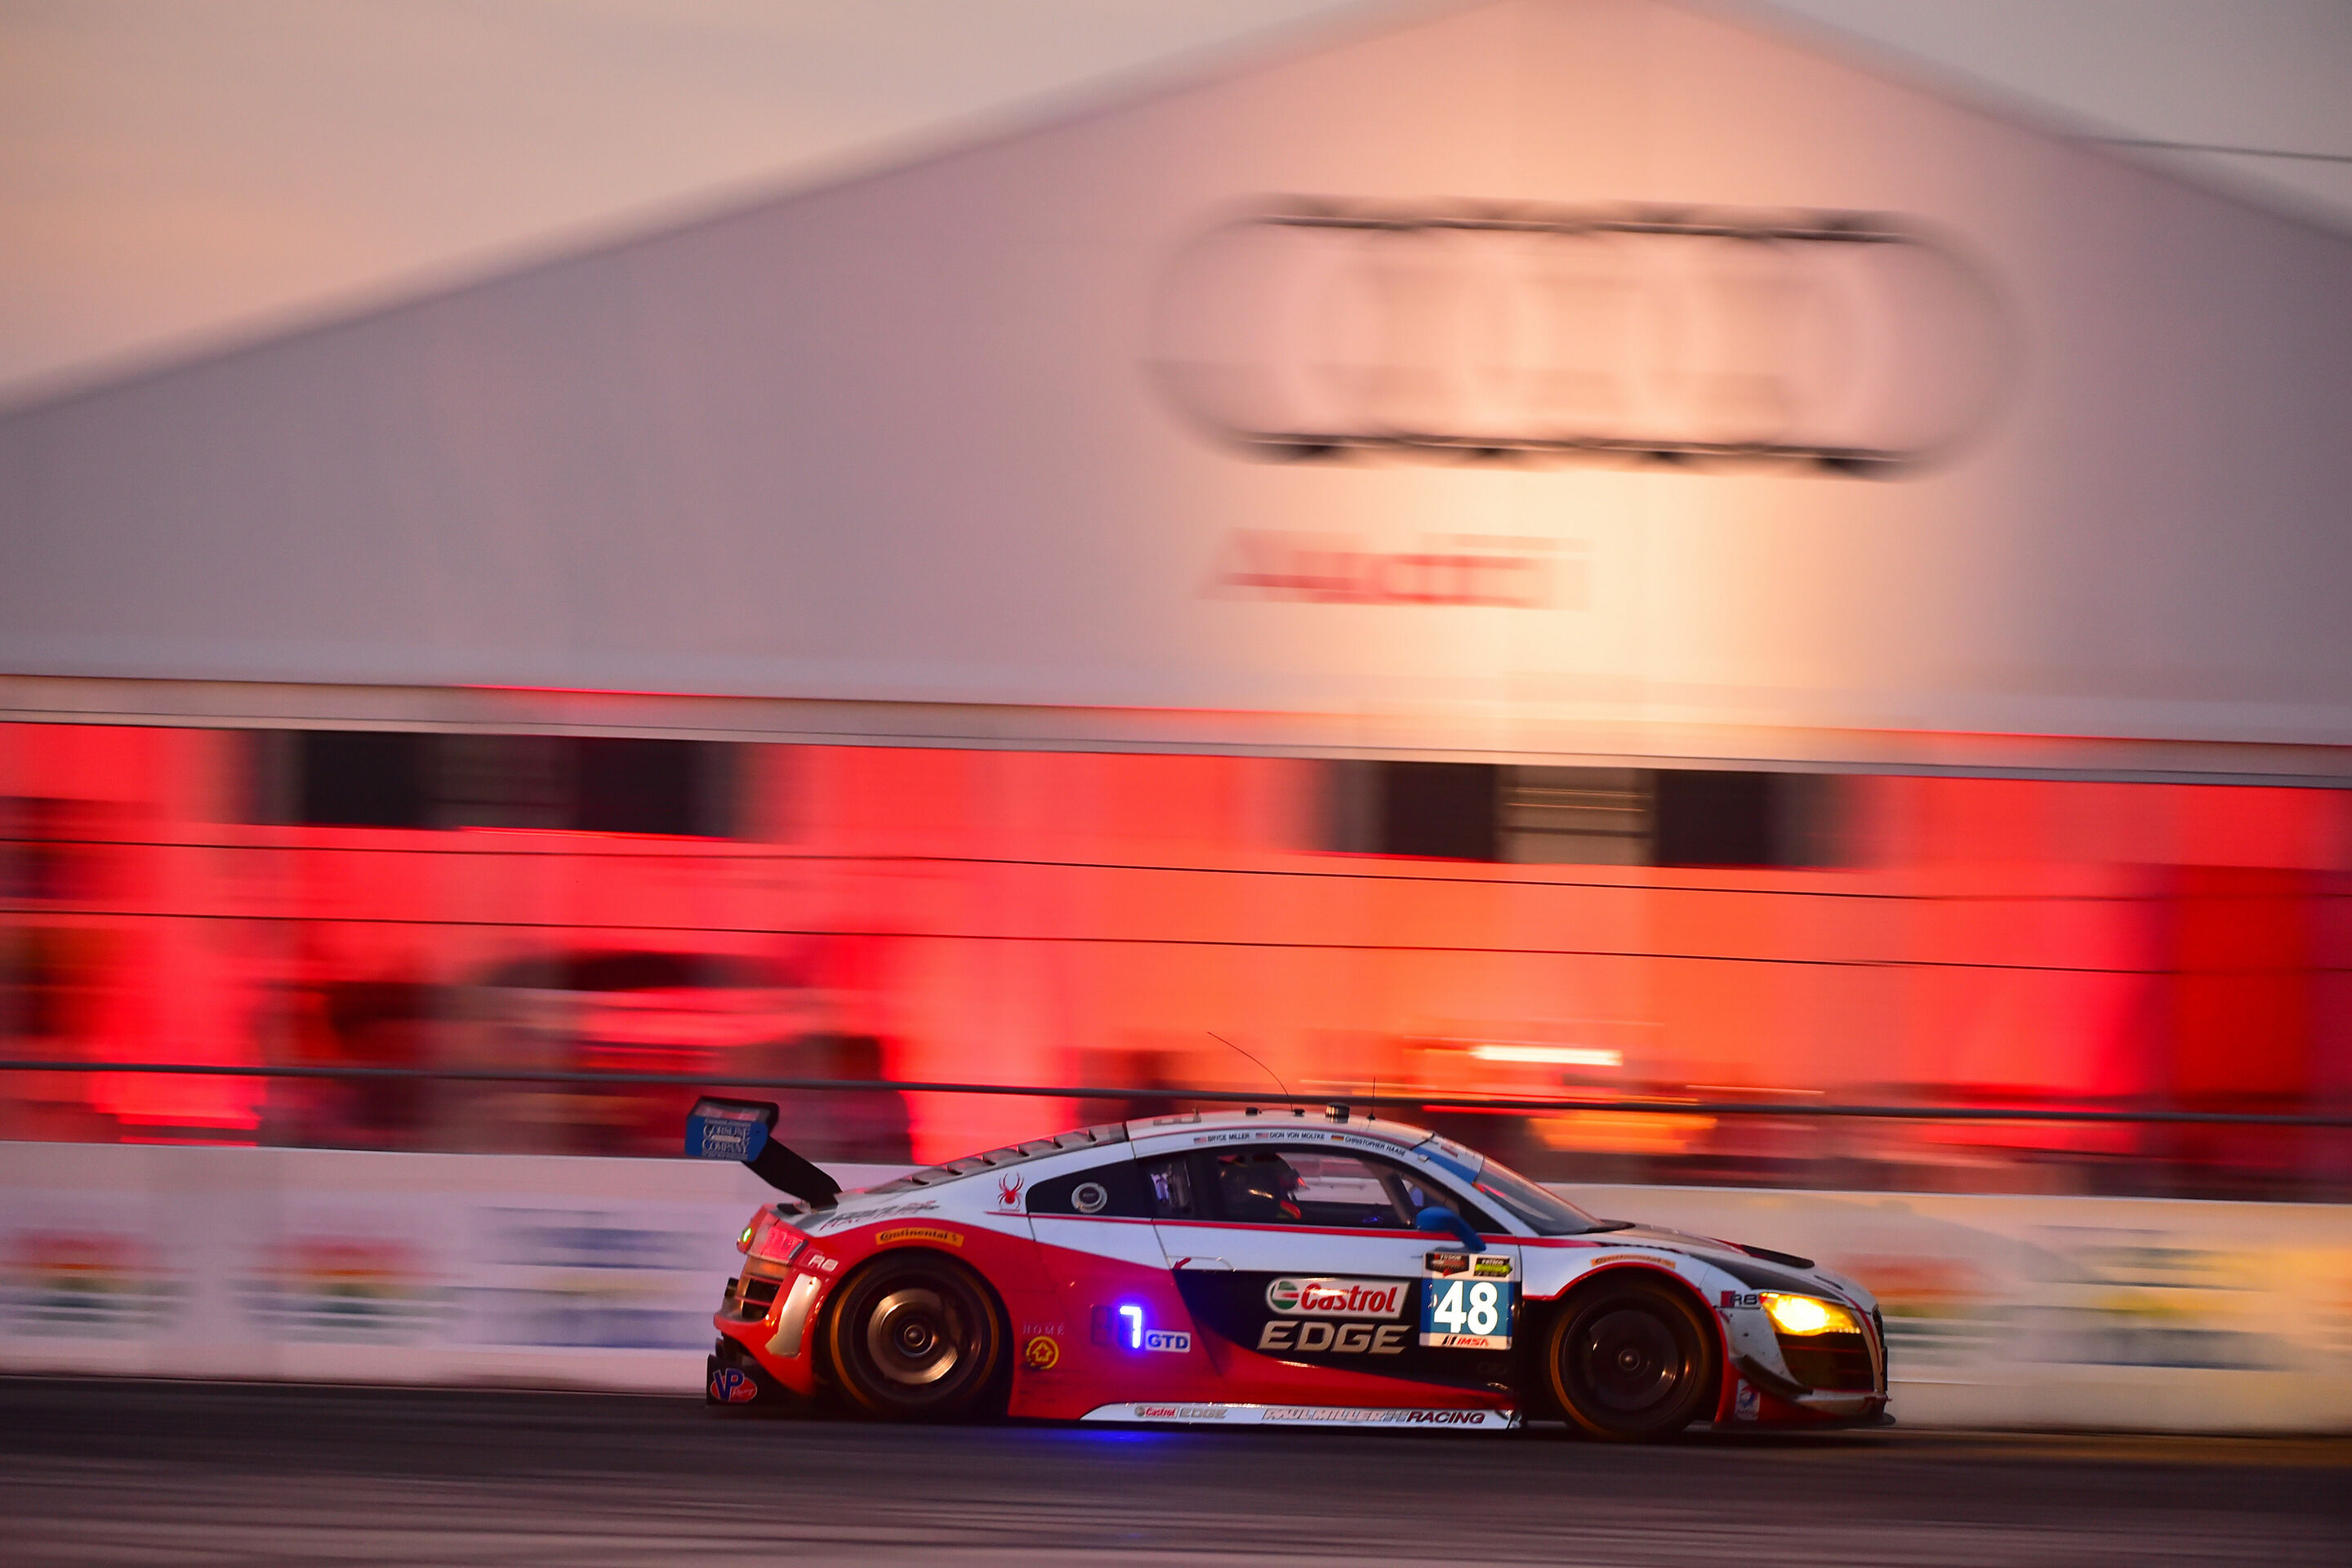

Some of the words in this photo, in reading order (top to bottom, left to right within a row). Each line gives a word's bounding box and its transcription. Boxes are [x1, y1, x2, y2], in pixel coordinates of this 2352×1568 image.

[1228, 1132, 1250, 1140] MILLER
[880, 1228, 947, 1241] Continental
[1301, 1283, 1397, 1312] Castrol
[1434, 1281, 1499, 1335] 48
[1022, 1323, 1065, 1336] HOME
[1147, 1333, 1188, 1349] GTD
[1257, 1321, 1413, 1354] EDGE
[1457, 1337, 1490, 1347] IMSA
[713, 1368, 745, 1401] VP
[1146, 1407, 1176, 1417] Castrol
[1179, 1408, 1227, 1419] EDGE
[1406, 1411, 1485, 1423] RACING
